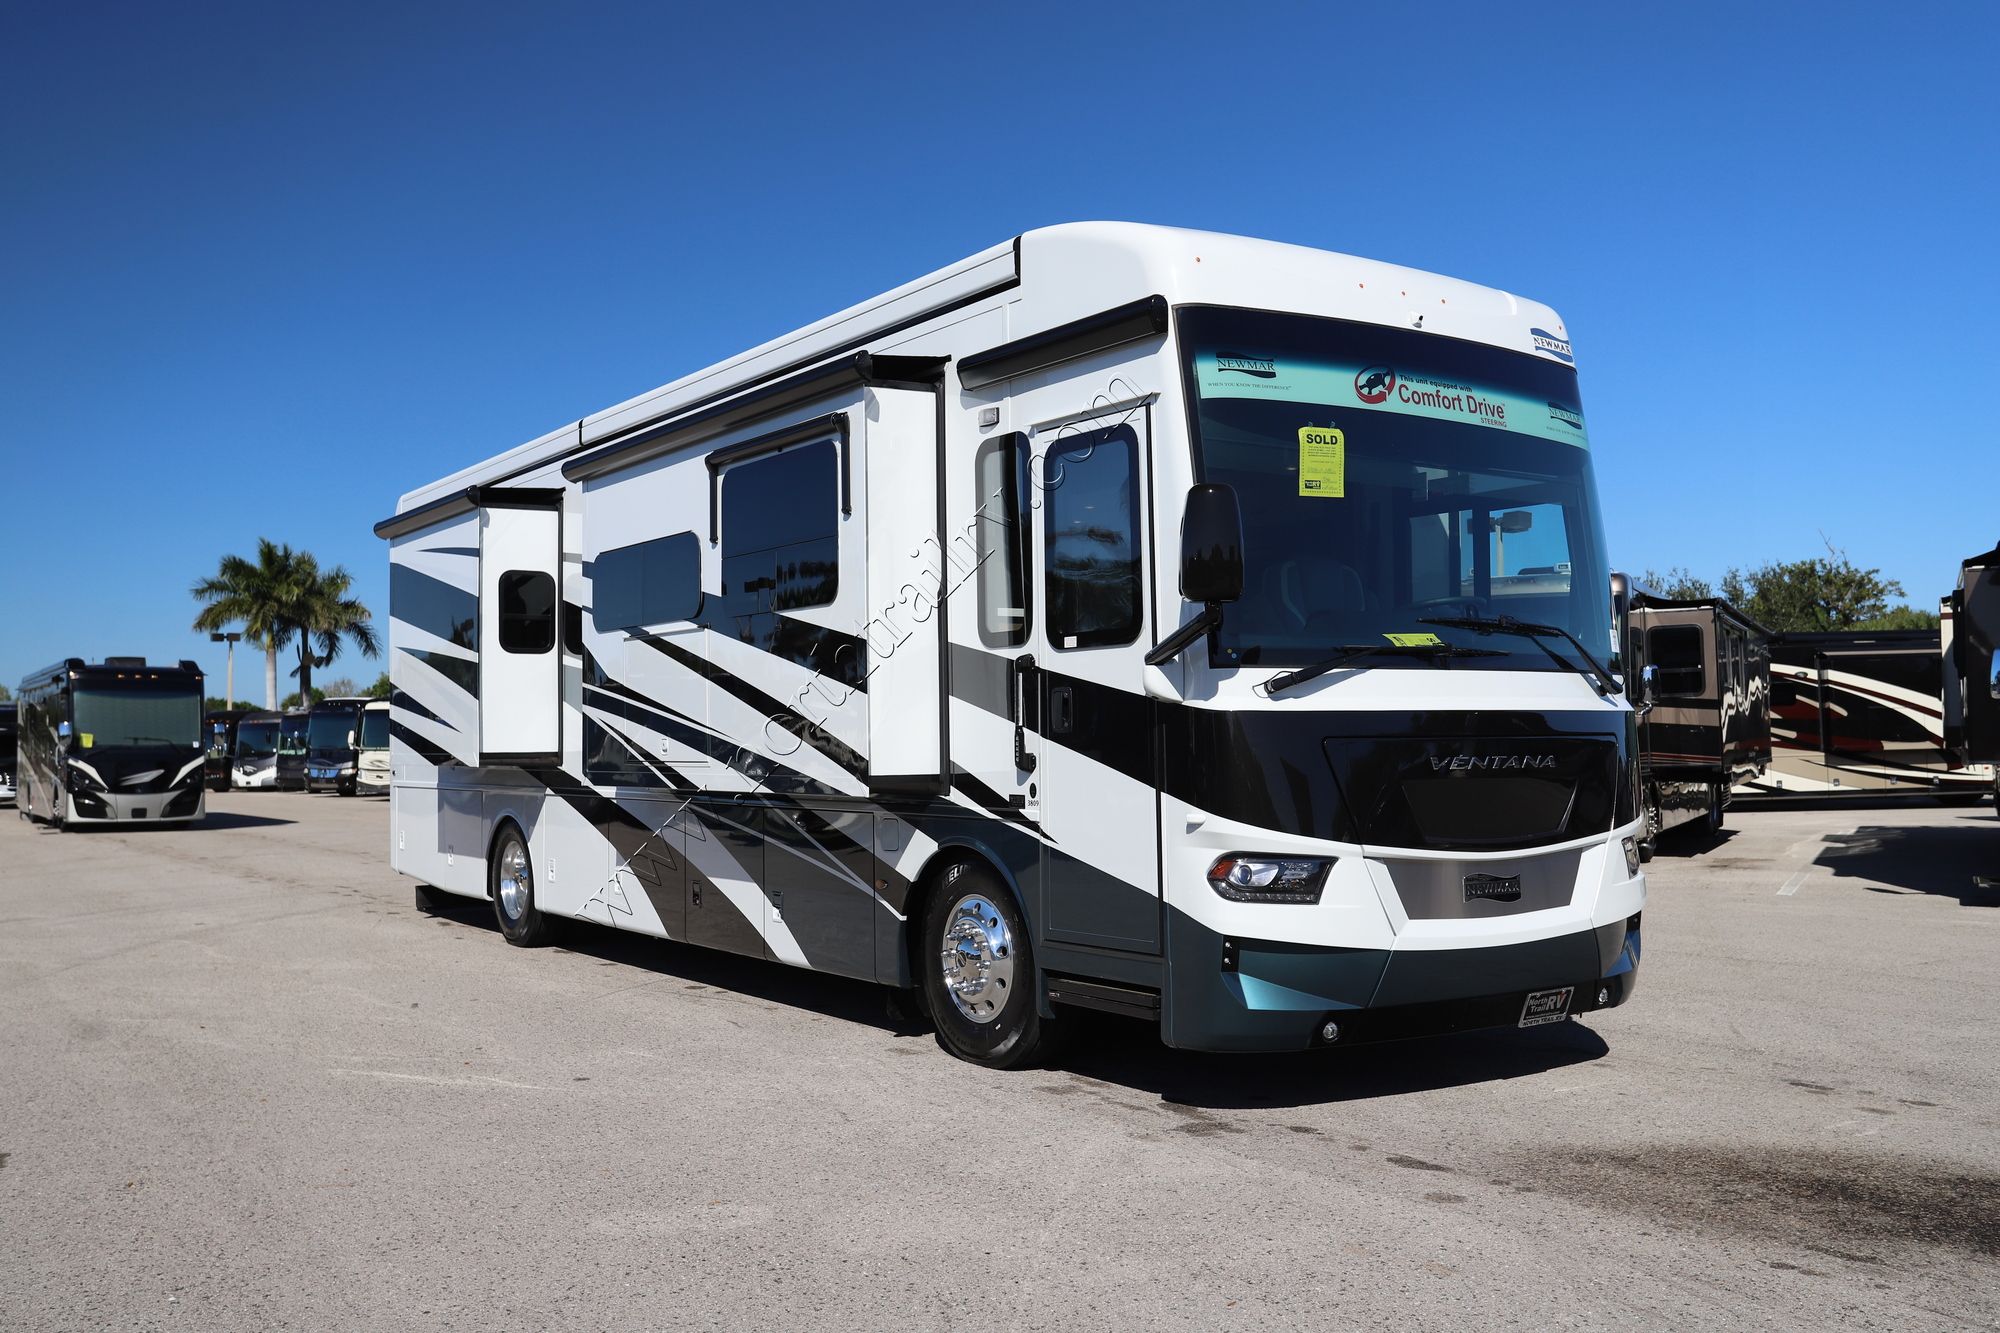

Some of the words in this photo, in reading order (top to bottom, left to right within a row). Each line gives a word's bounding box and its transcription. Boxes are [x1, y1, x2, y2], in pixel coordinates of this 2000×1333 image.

[1533, 336, 1571, 355] NEWMAR
[1217, 359, 1275, 371] NEWMAR
[1399, 375, 1415, 383] This
[1415, 377, 1428, 385] unit
[1429, 380, 1458, 390] equipped
[1458, 384, 1473, 393] with
[1398, 384, 1464, 412] Comfort
[1467, 395, 1505, 419] Drive
[1480, 417, 1507, 428] STEERING
[1548, 407, 1581, 423] NEWMAR
[1306, 433, 1338, 445] SOLD
[1430, 755, 1557, 770] VENTANA
[1466, 881, 1520, 896] NEWMAR
[1529, 997, 1548, 1006] North
[1546, 993, 1567, 1010] RV
[1530, 1004, 1546, 1013] Trail
